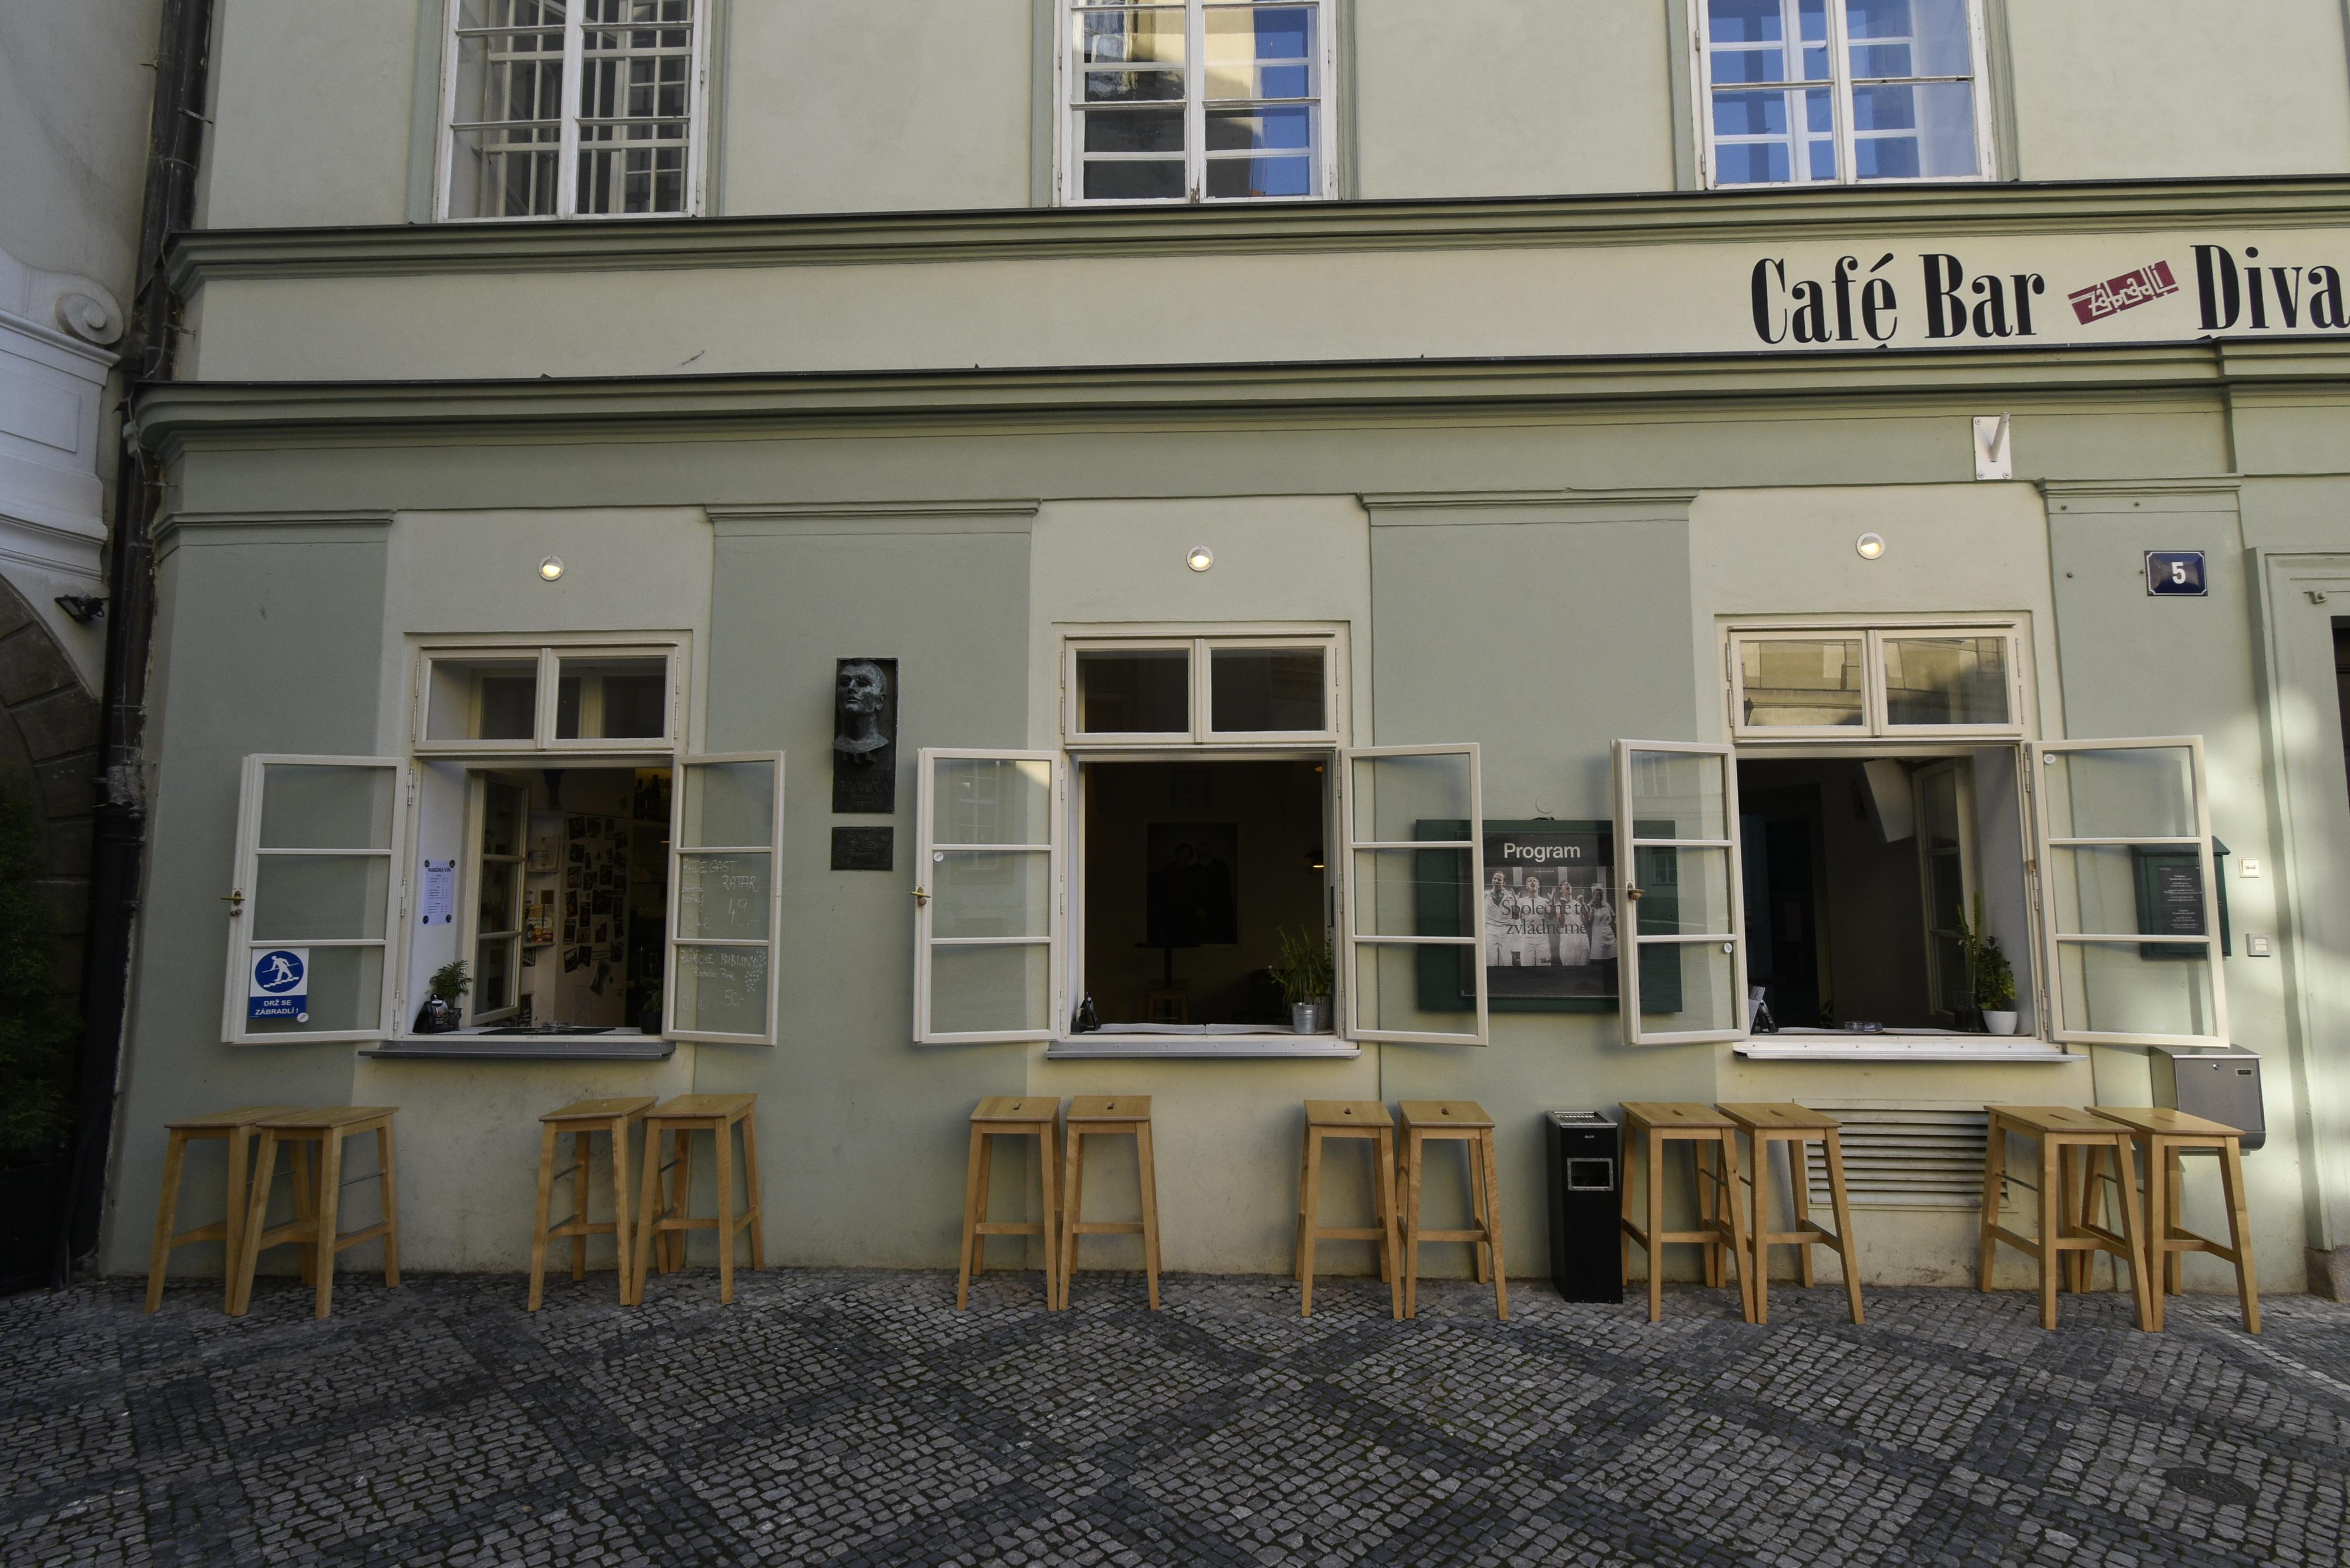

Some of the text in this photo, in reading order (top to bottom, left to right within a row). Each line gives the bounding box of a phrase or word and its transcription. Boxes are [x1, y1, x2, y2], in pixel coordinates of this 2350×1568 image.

[2190, 244, 2350, 330] Diva
[1751, 253, 2044, 344] Café Bar
[2171, 562, 2186, 584] 5
[1504, 842, 1580, 862] Program
[721, 875, 760, 892] RATAR
[1505, 919, 1587, 935] zvládneme
[721, 953, 756, 969] BUBLINY
[255, 1007, 294, 1015] ZÁBRADLÍ
